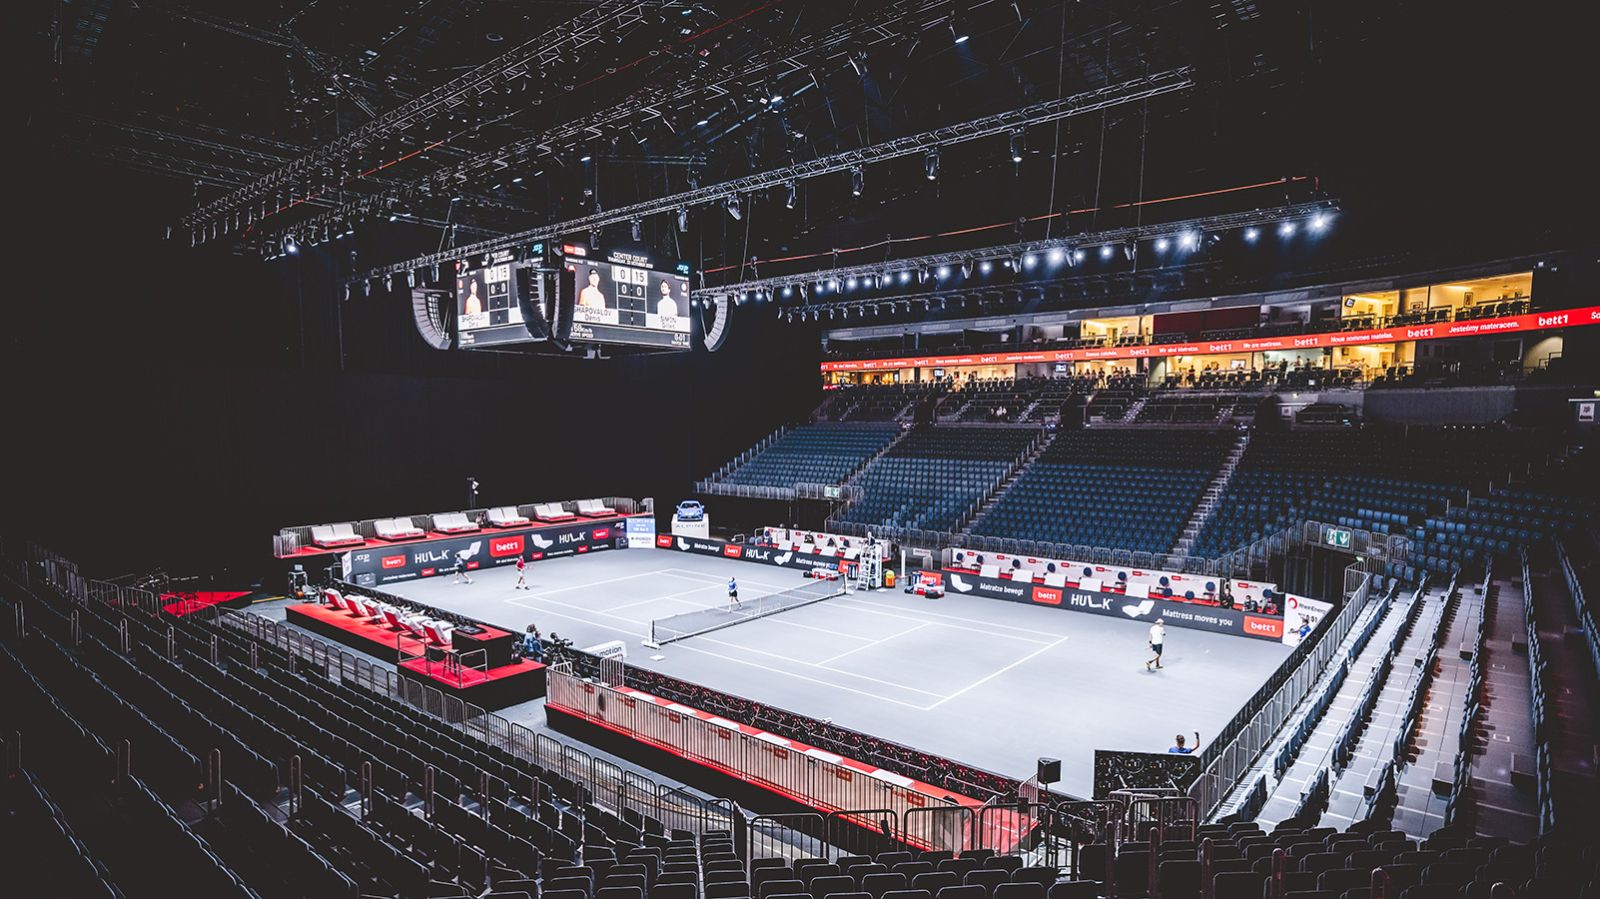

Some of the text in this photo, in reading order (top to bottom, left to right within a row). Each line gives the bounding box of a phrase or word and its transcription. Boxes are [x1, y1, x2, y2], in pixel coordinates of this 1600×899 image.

[620, 269, 645, 283] 0 15
[621, 284, 642, 297] 0 0
[1538, 315, 1569, 326] bett1
[1407, 328, 1434, 338] bett1
[1449, 321, 1520, 334] Jesteśmy materacem.
[1209, 343, 1232, 352] bett1
[1294, 337, 1318, 347] bett1
[496, 541, 518, 552] bett1
[980, 583, 1024, 596] Matratze bewegt
[1038, 591, 1056, 600] bett1
[1162, 608, 1233, 627] Mattress moves you
[1250, 621, 1276, 632] bett1
